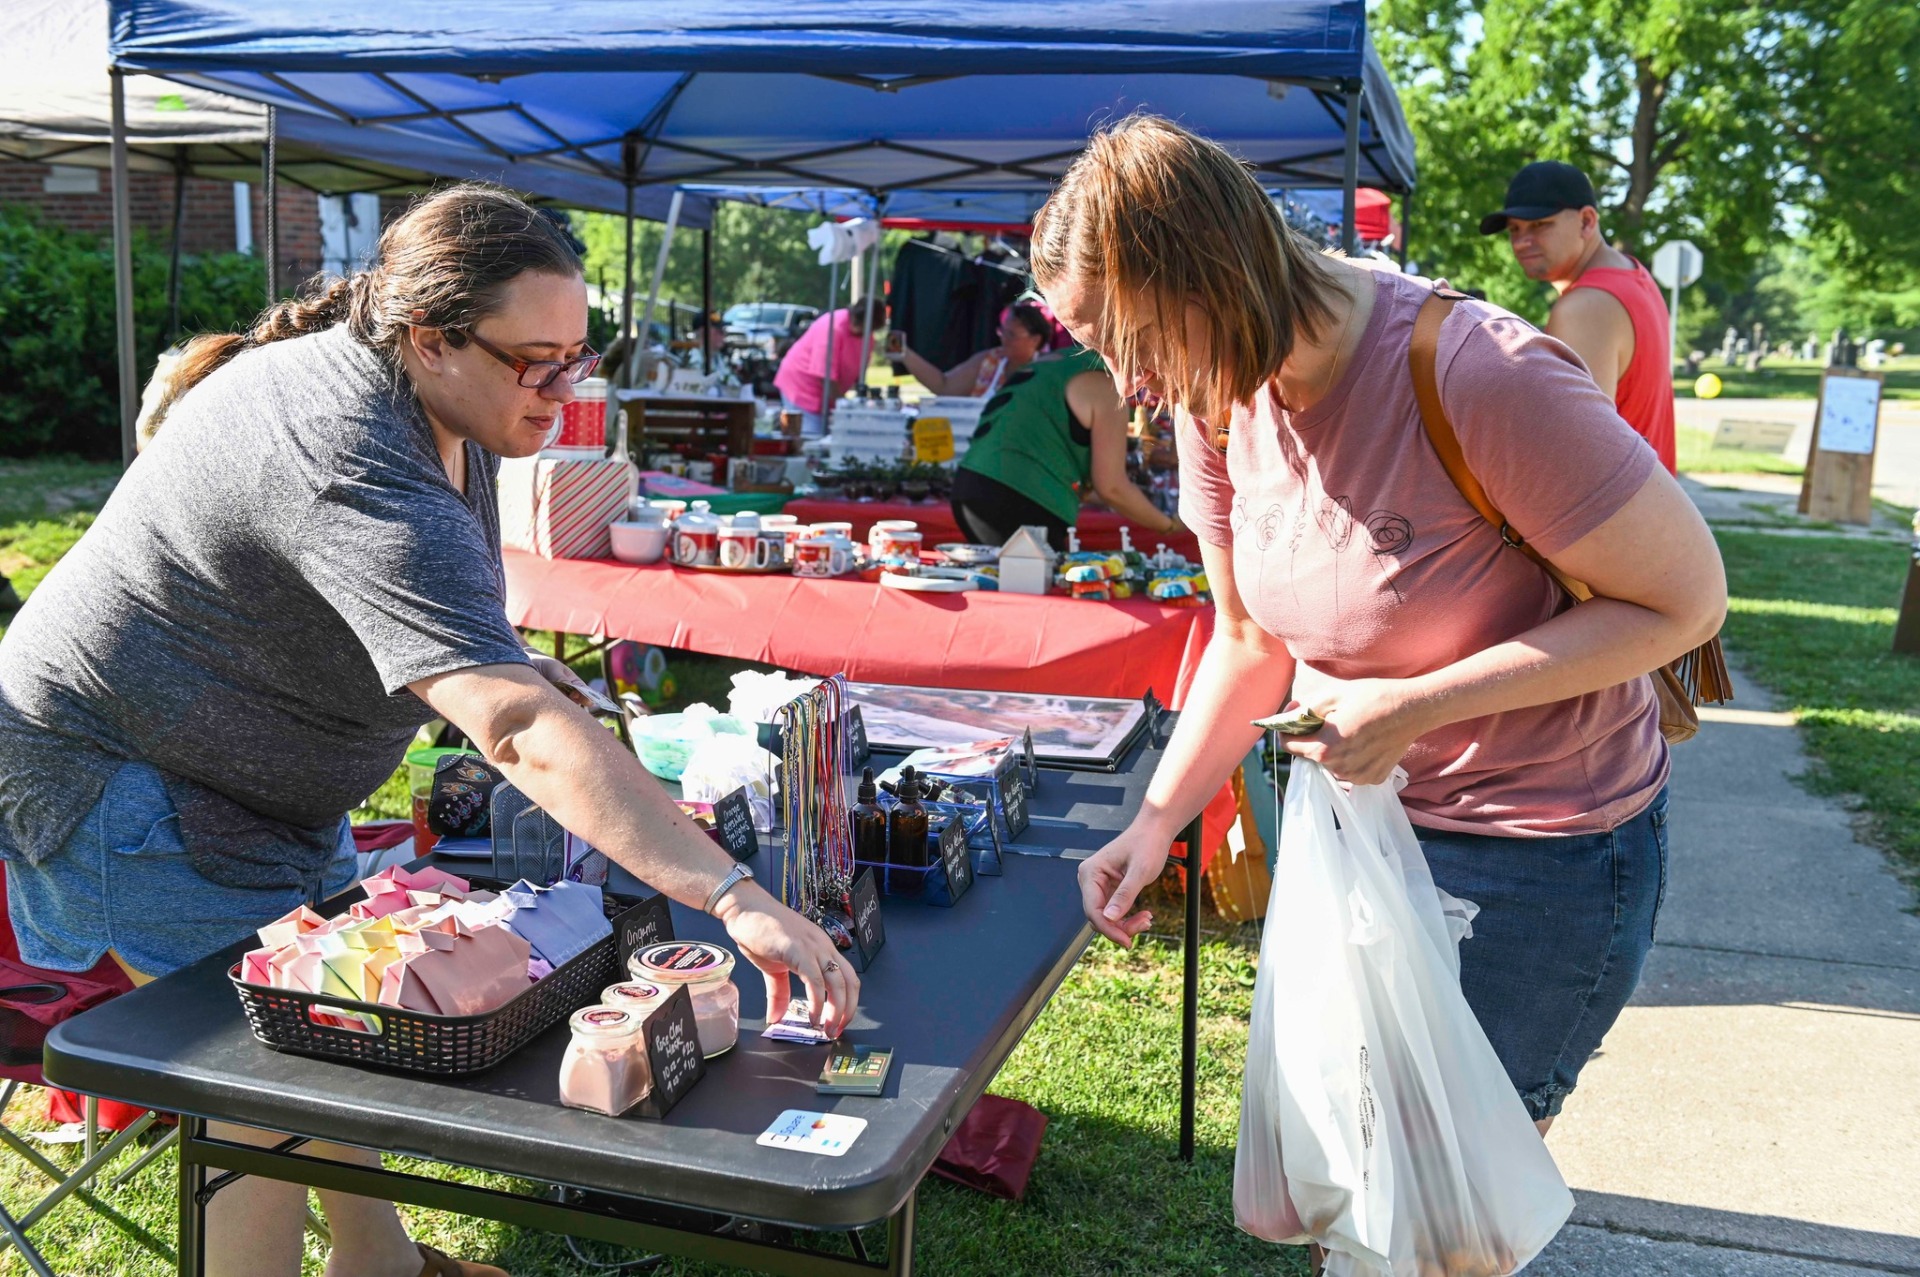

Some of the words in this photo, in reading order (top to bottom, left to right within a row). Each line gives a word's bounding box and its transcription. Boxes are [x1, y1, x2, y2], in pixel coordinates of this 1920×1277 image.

[627, 916, 657, 947] Origami
[655, 1034, 669, 1053] Rose
[668, 1018, 684, 1040] Clay
[682, 1040, 695, 1057] $20
[683, 1057, 696, 1071] $10
